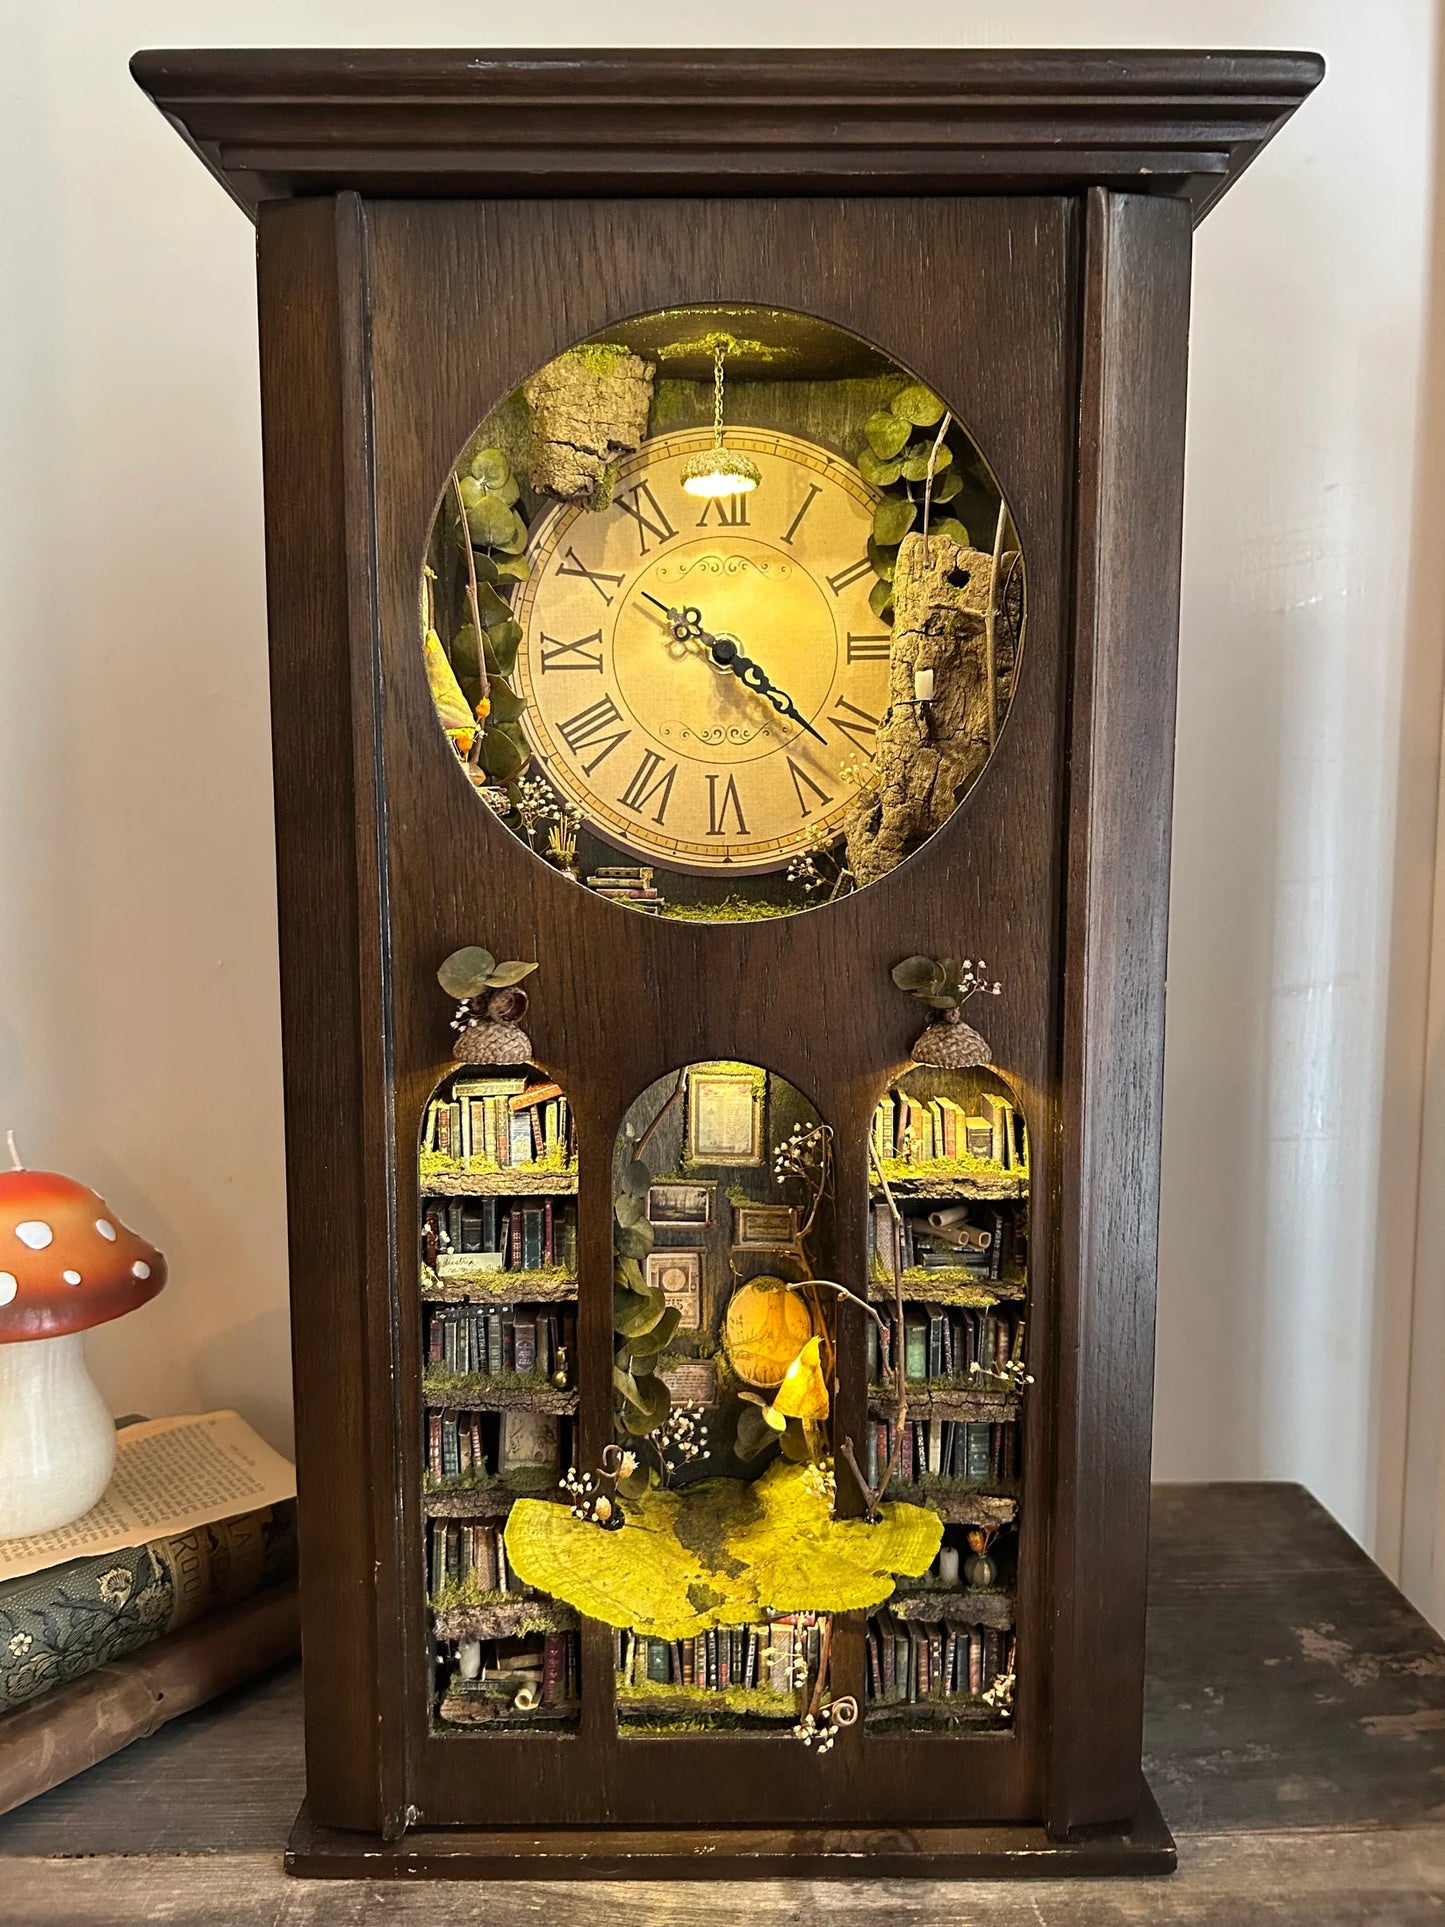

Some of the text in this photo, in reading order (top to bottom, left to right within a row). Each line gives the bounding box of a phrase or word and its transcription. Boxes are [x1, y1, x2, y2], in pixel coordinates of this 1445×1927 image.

[612, 479, 680, 556] XI
[780, 482, 823, 545] I
[555, 546, 626, 607] X
[825, 556, 873, 597] II
[540, 628, 603, 675] IX
[847, 631, 890, 665] III
[555, 692, 632, 778] VIII
[827, 695, 881, 762] IV
[617, 748, 678, 826] VII
[705, 773, 751, 835] VI
[786, 755, 834, 818] V
